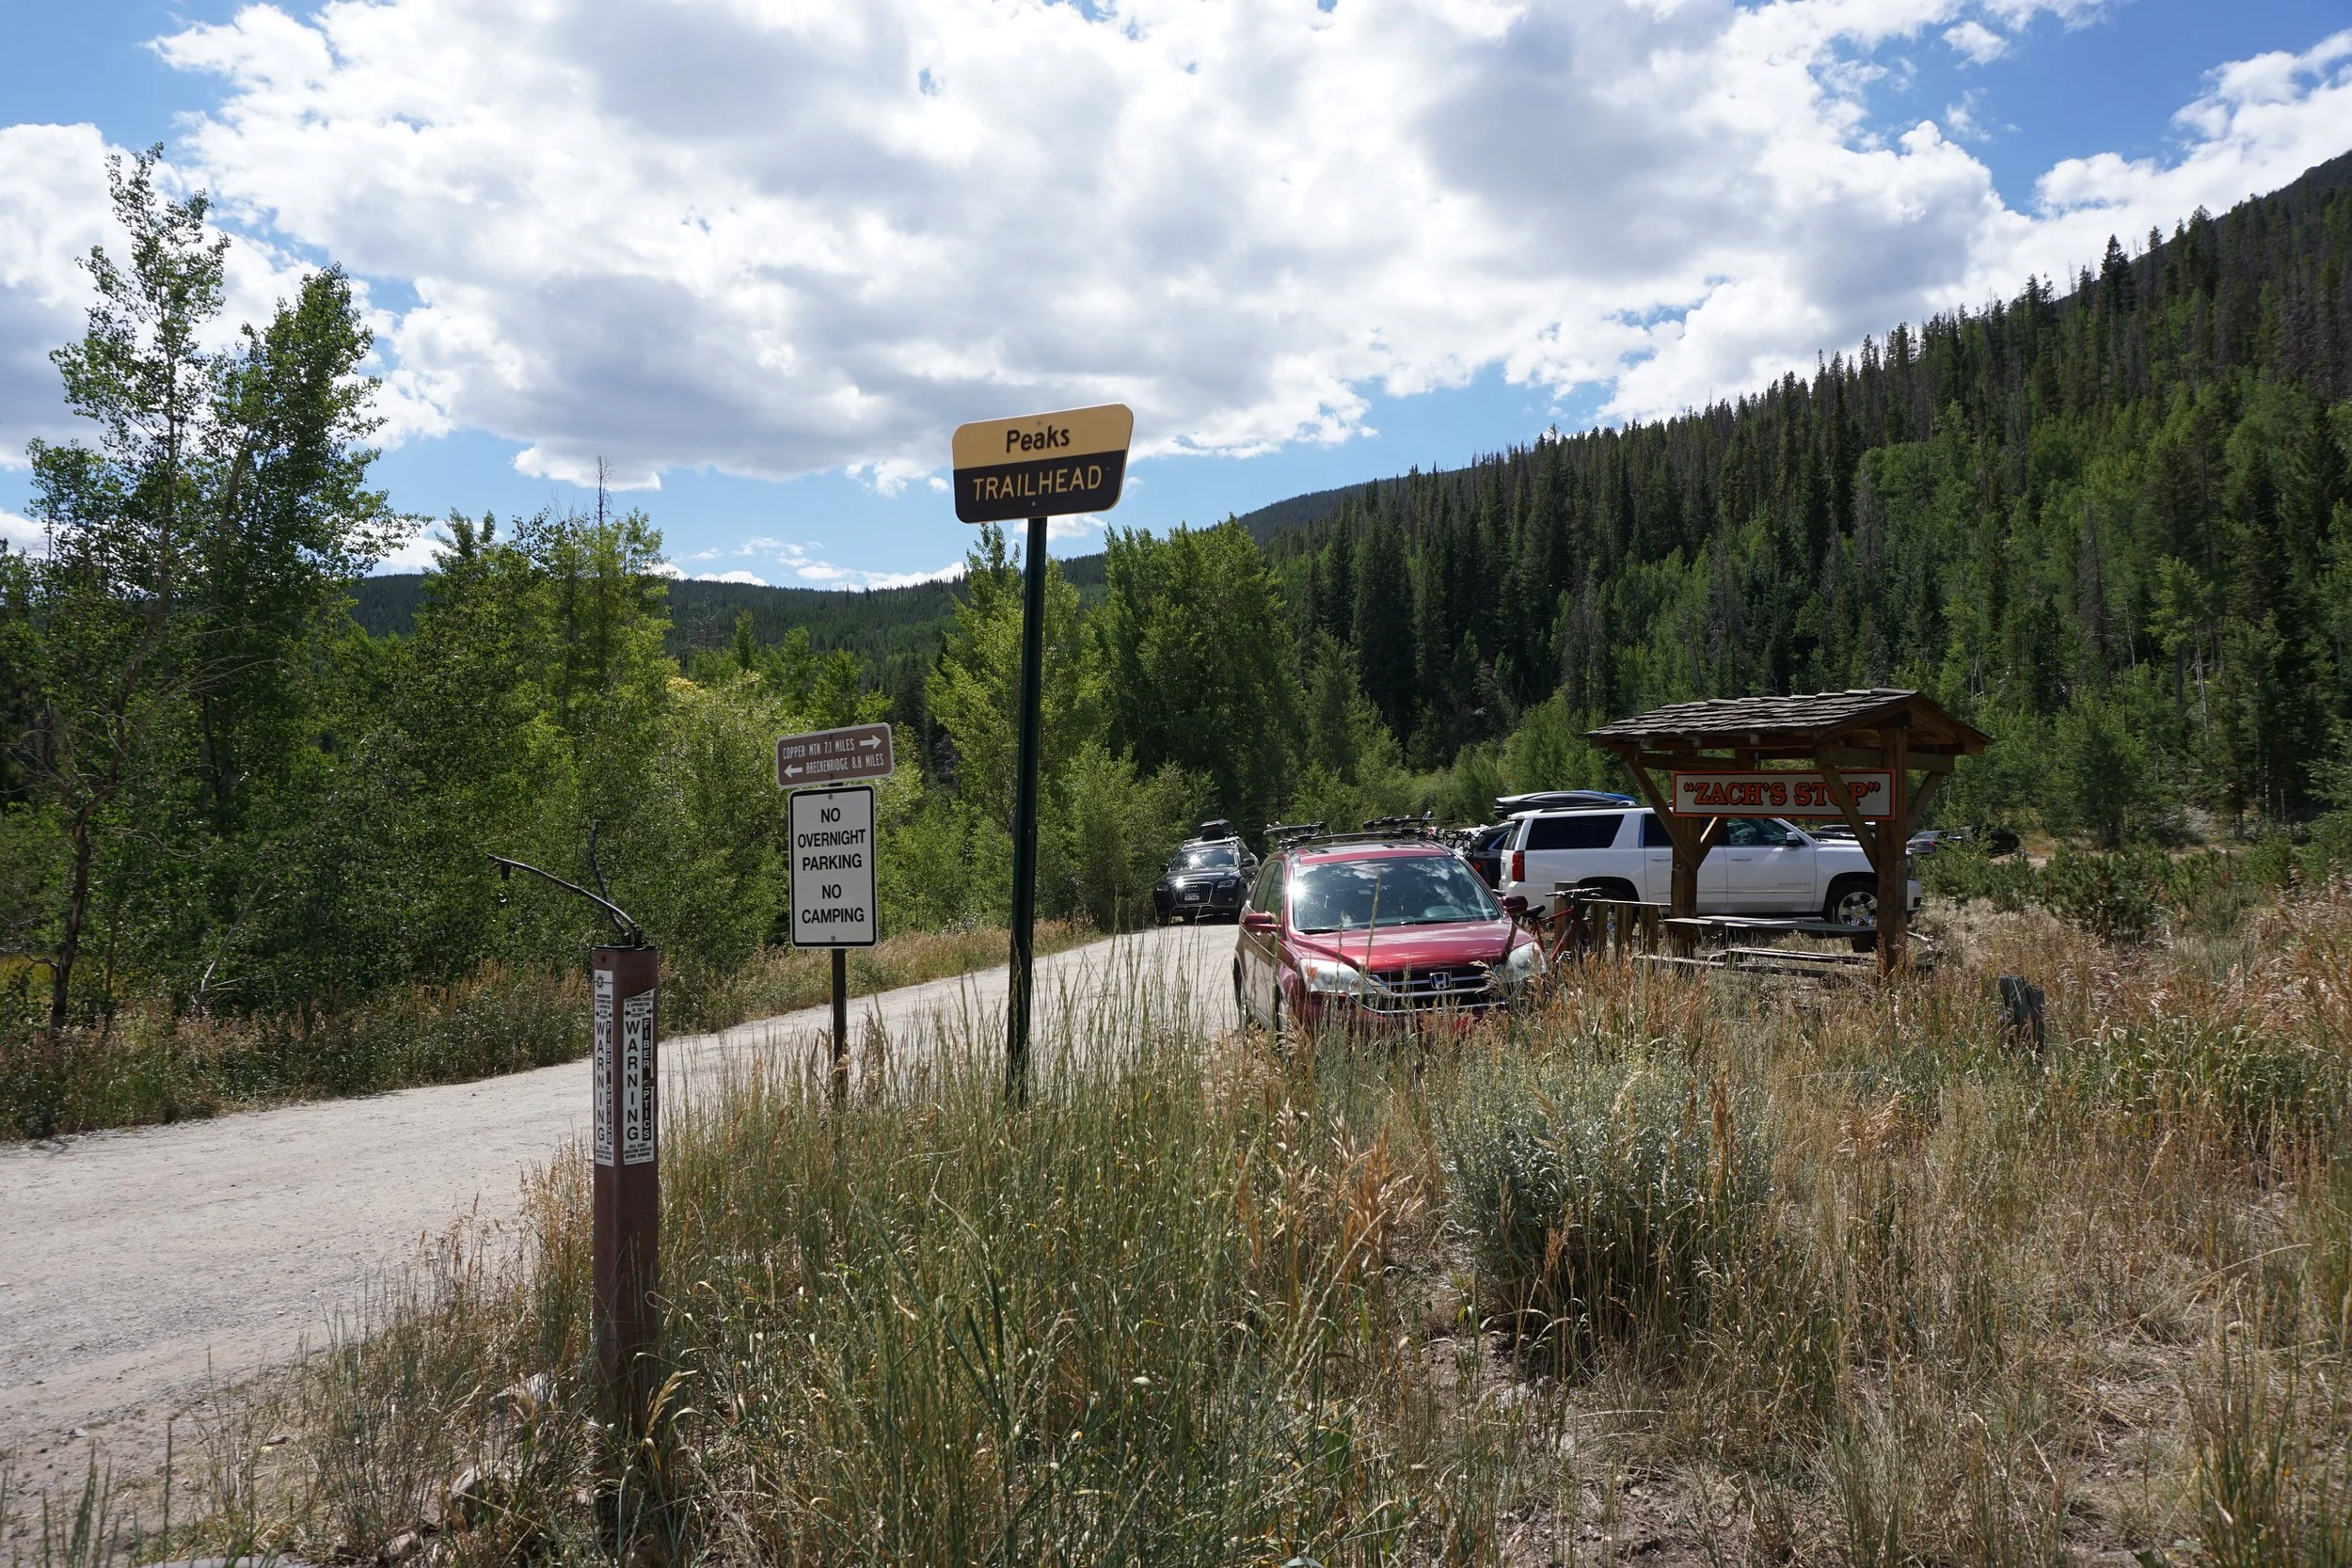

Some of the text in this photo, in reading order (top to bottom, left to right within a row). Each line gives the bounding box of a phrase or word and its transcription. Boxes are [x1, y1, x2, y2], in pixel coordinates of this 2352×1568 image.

[1006, 425, 1070, 453] Peaks
[973, 465, 1102, 501] TRAILHEAD
[783, 737, 855, 760] COPPER MTN 7.1 MILES
[805, 757, 849, 774] BRECKENRIDGE
[866, 753, 884, 768] MILES
[820, 807, 841, 823] NO
[797, 829, 866, 848] OVERNIGHT
[803, 853, 862, 871] PARKING
[821, 884, 842, 899] NO
[802, 908, 865, 924] CAMPING
[596, 1021, 605, 1141] WARNING
[625, 1021, 640, 1141] WARNING
